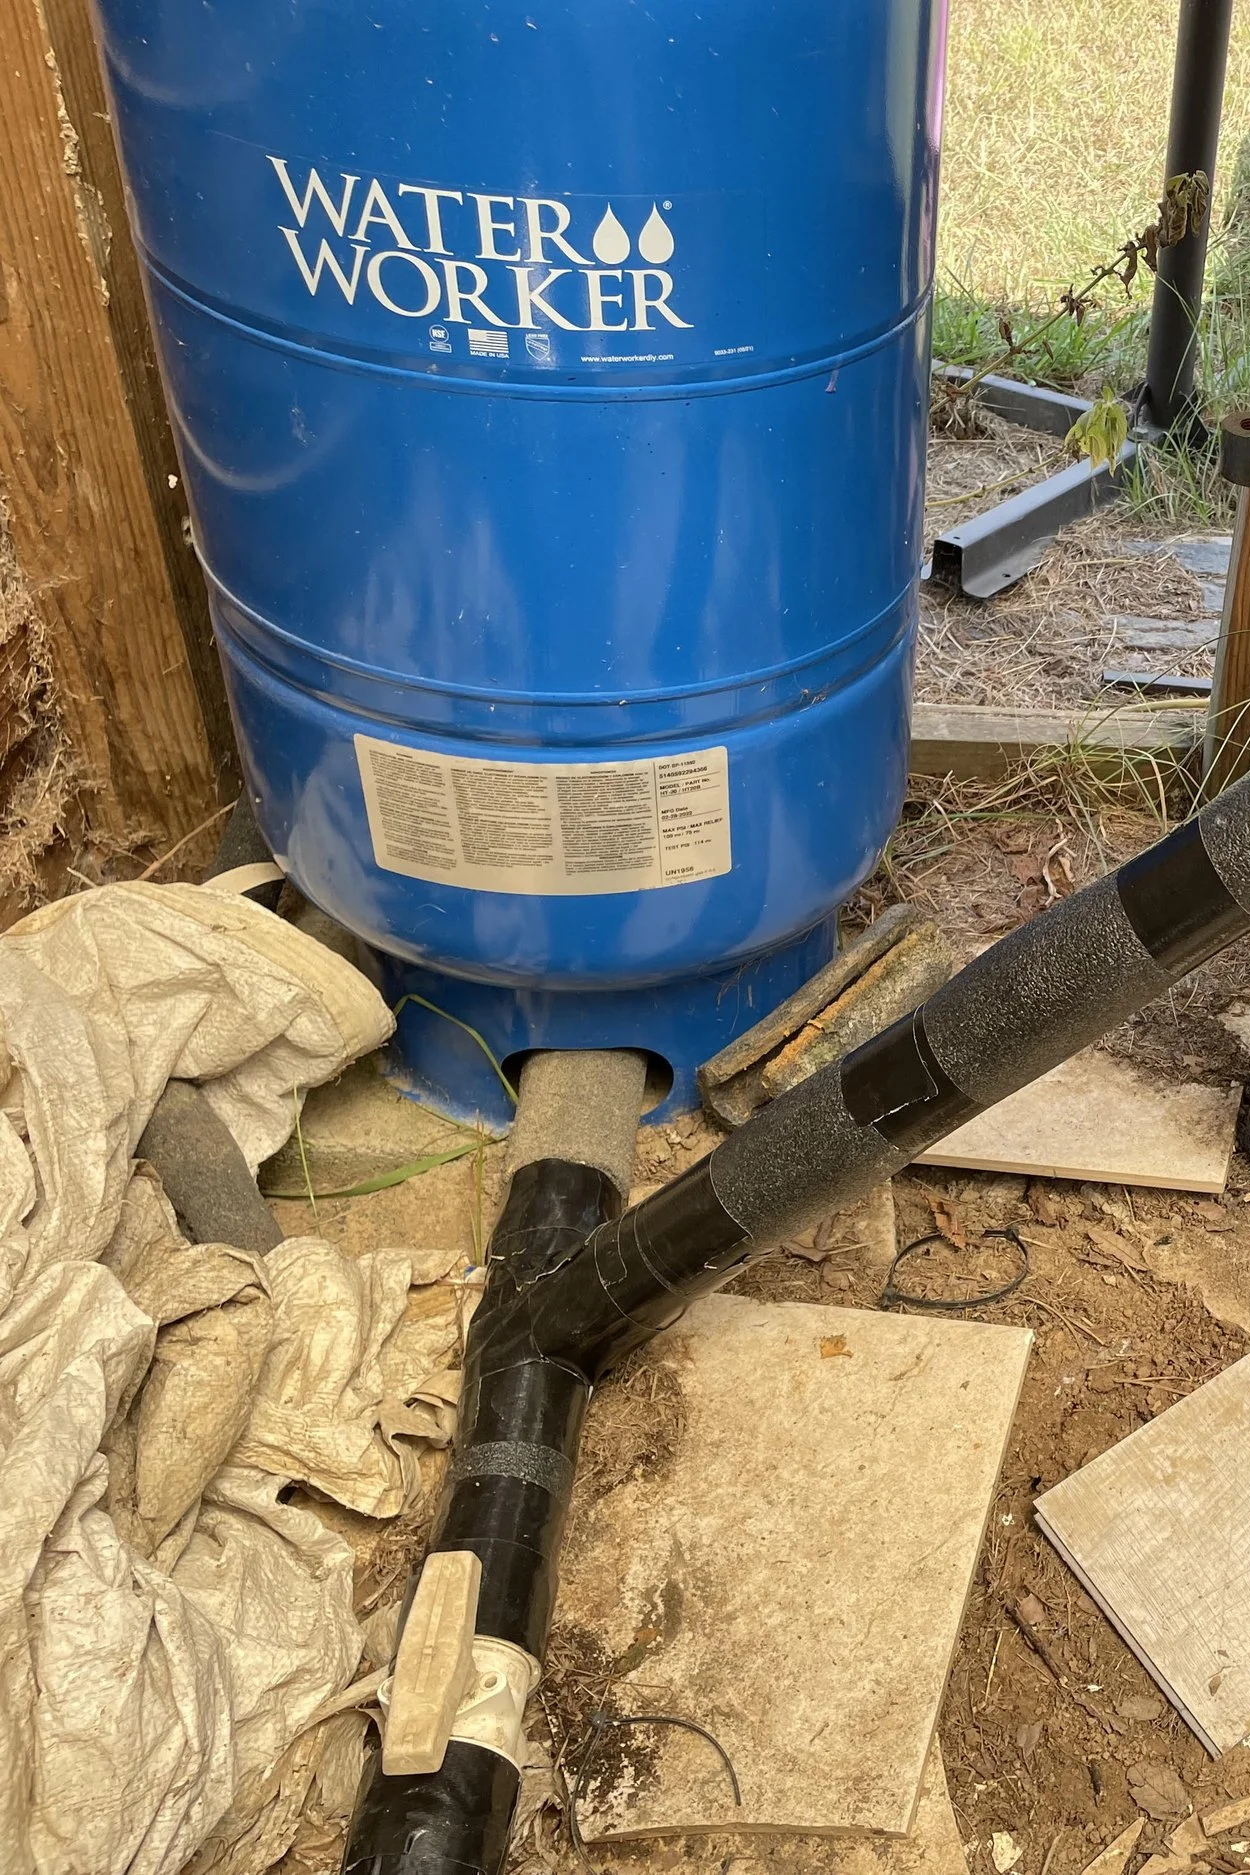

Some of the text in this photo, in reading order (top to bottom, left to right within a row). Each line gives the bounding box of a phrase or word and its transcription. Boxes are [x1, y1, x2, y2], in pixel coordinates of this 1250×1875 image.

[265, 154, 596, 265] WATER
[277, 225, 695, 332] WORKER
[470, 350, 487, 358] MADE
[581, 353, 674, 363] www.waterworkerdiy.com
